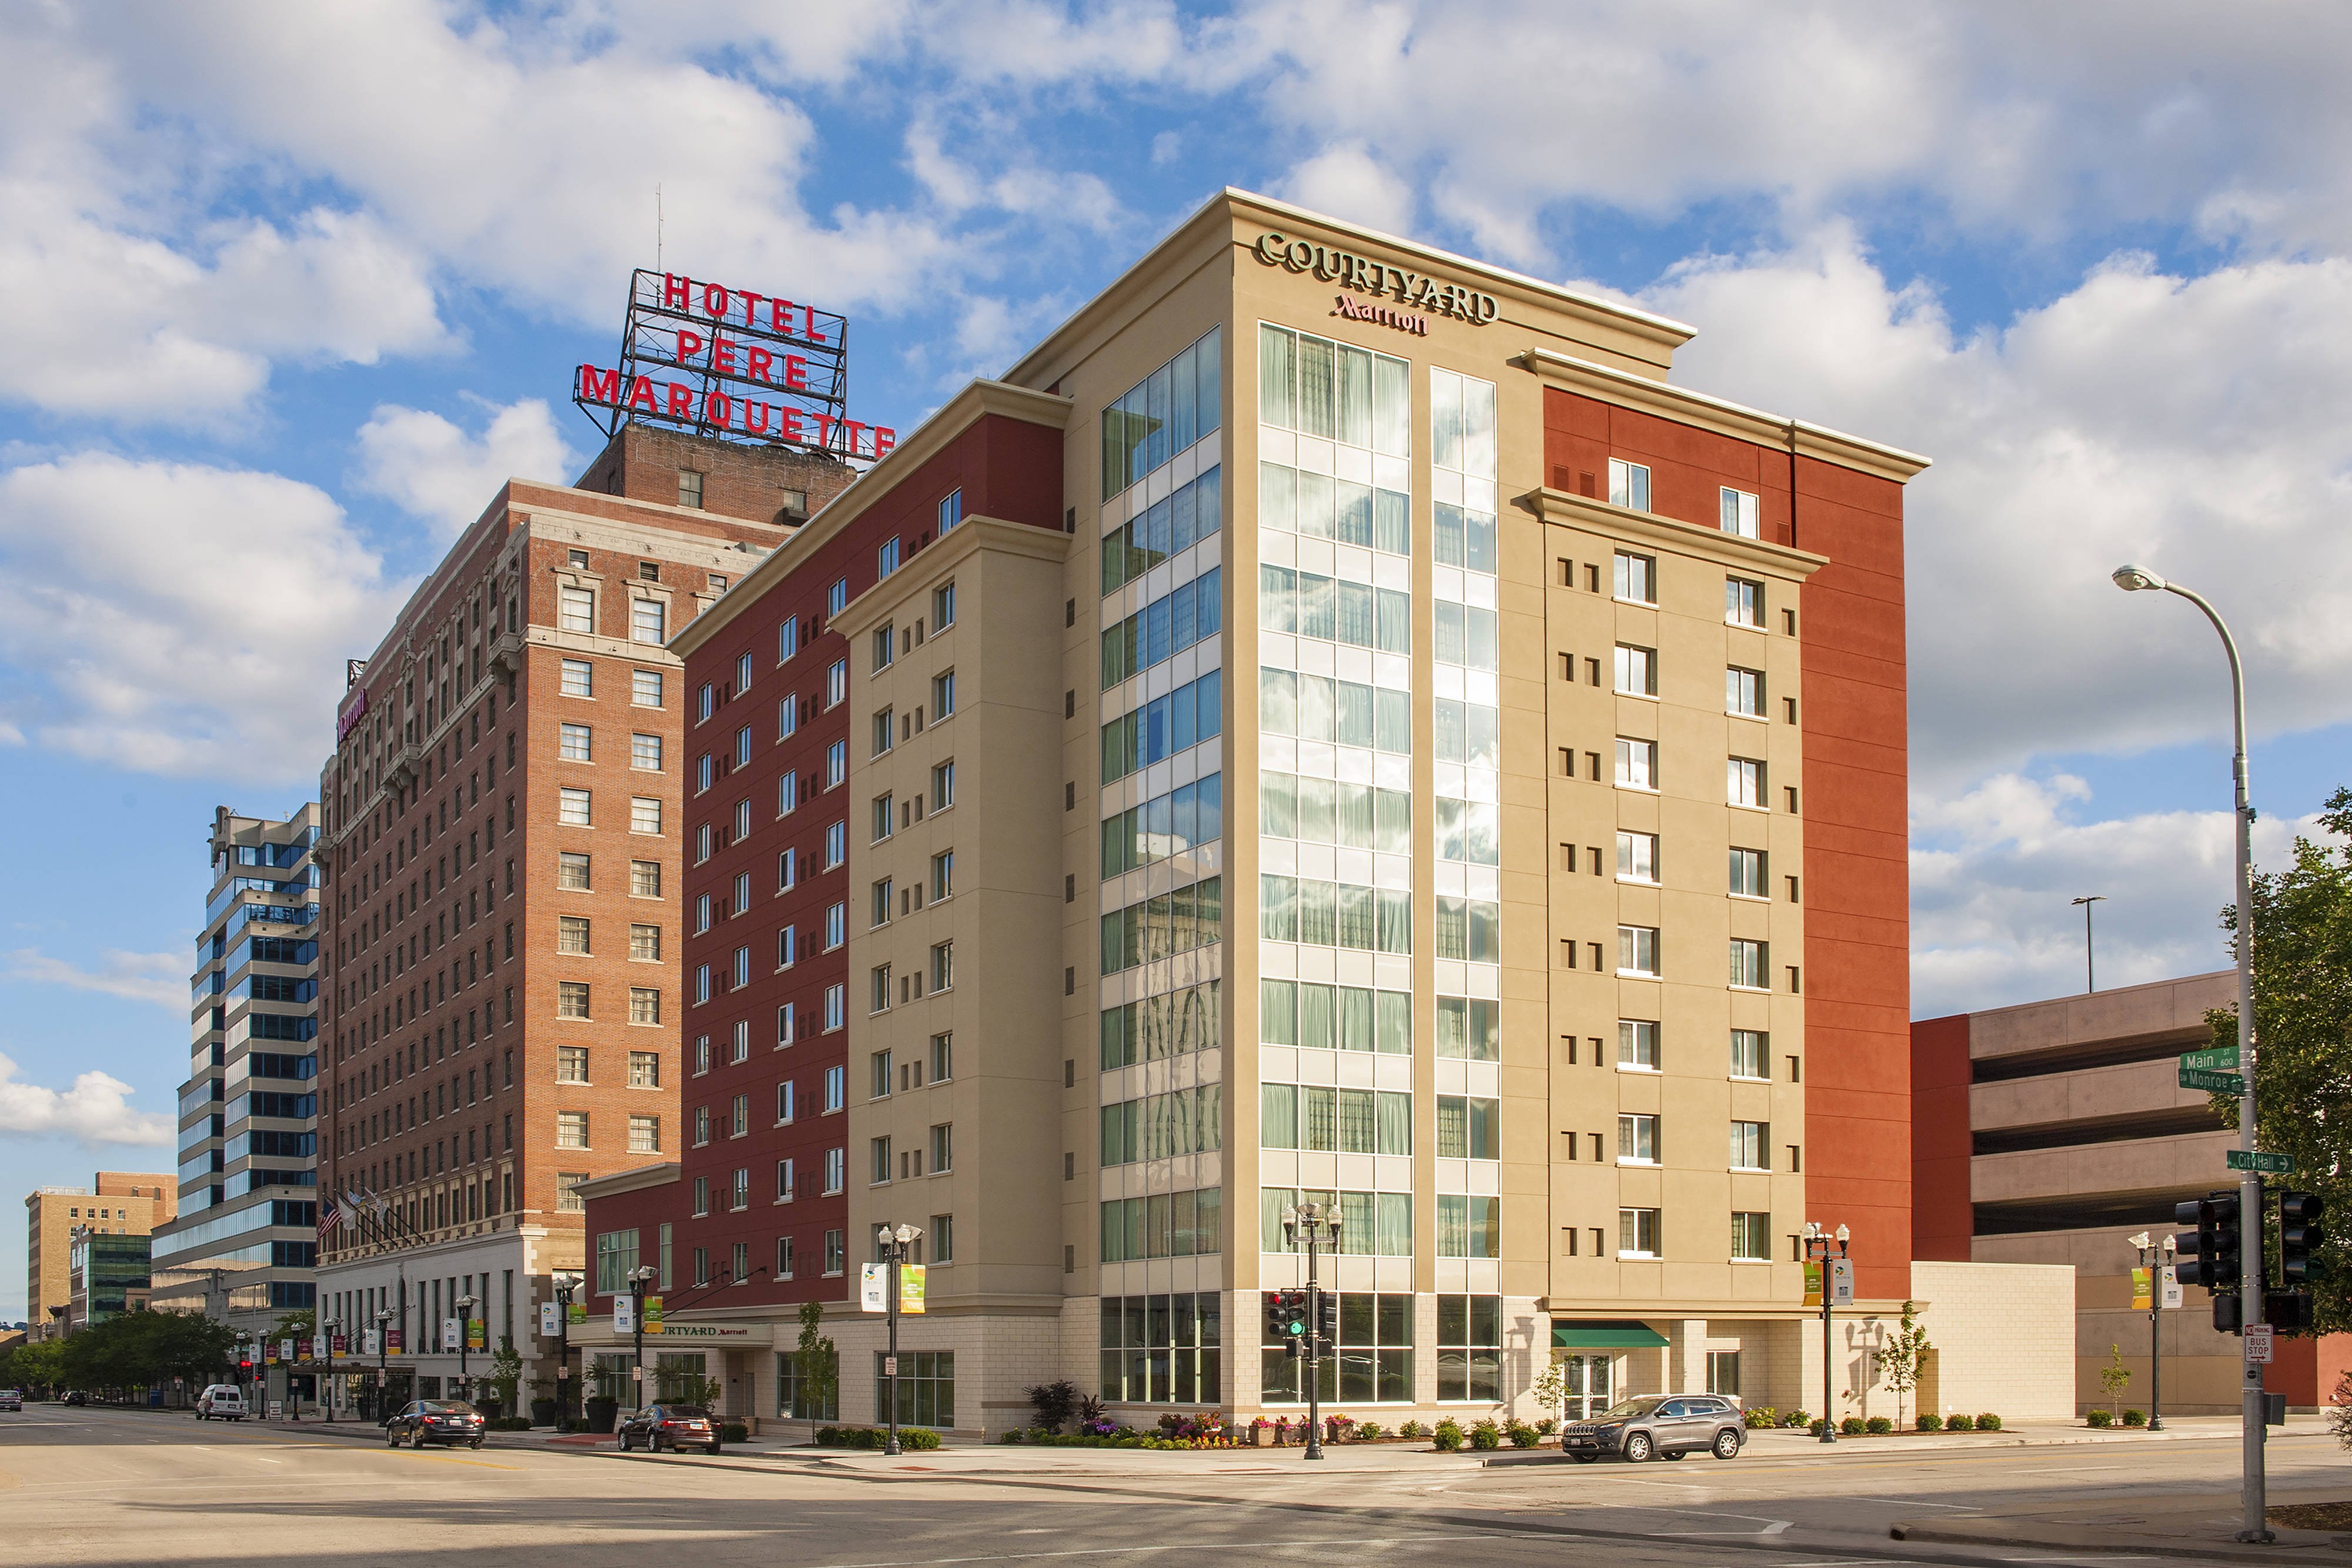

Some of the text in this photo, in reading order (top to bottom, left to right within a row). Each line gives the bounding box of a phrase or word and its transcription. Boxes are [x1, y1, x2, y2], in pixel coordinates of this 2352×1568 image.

[1261, 231, 1501, 324] COURTYARD
[664, 272, 826, 343] HOTEL
[1335, 293, 1430, 335] Marriott
[676, 329, 807, 390] PERE
[581, 363, 896, 459] MARQUETTE
[2187, 1054, 2213, 1069] Main
[2220, 1058, 2233, 1066] 600
[2189, 1071, 2227, 1088] Monroe
[2239, 1154, 2273, 1170] City Hall
[2246, 1326, 2253, 1335] NO
[2250, 1338, 2266, 1346] BUS
